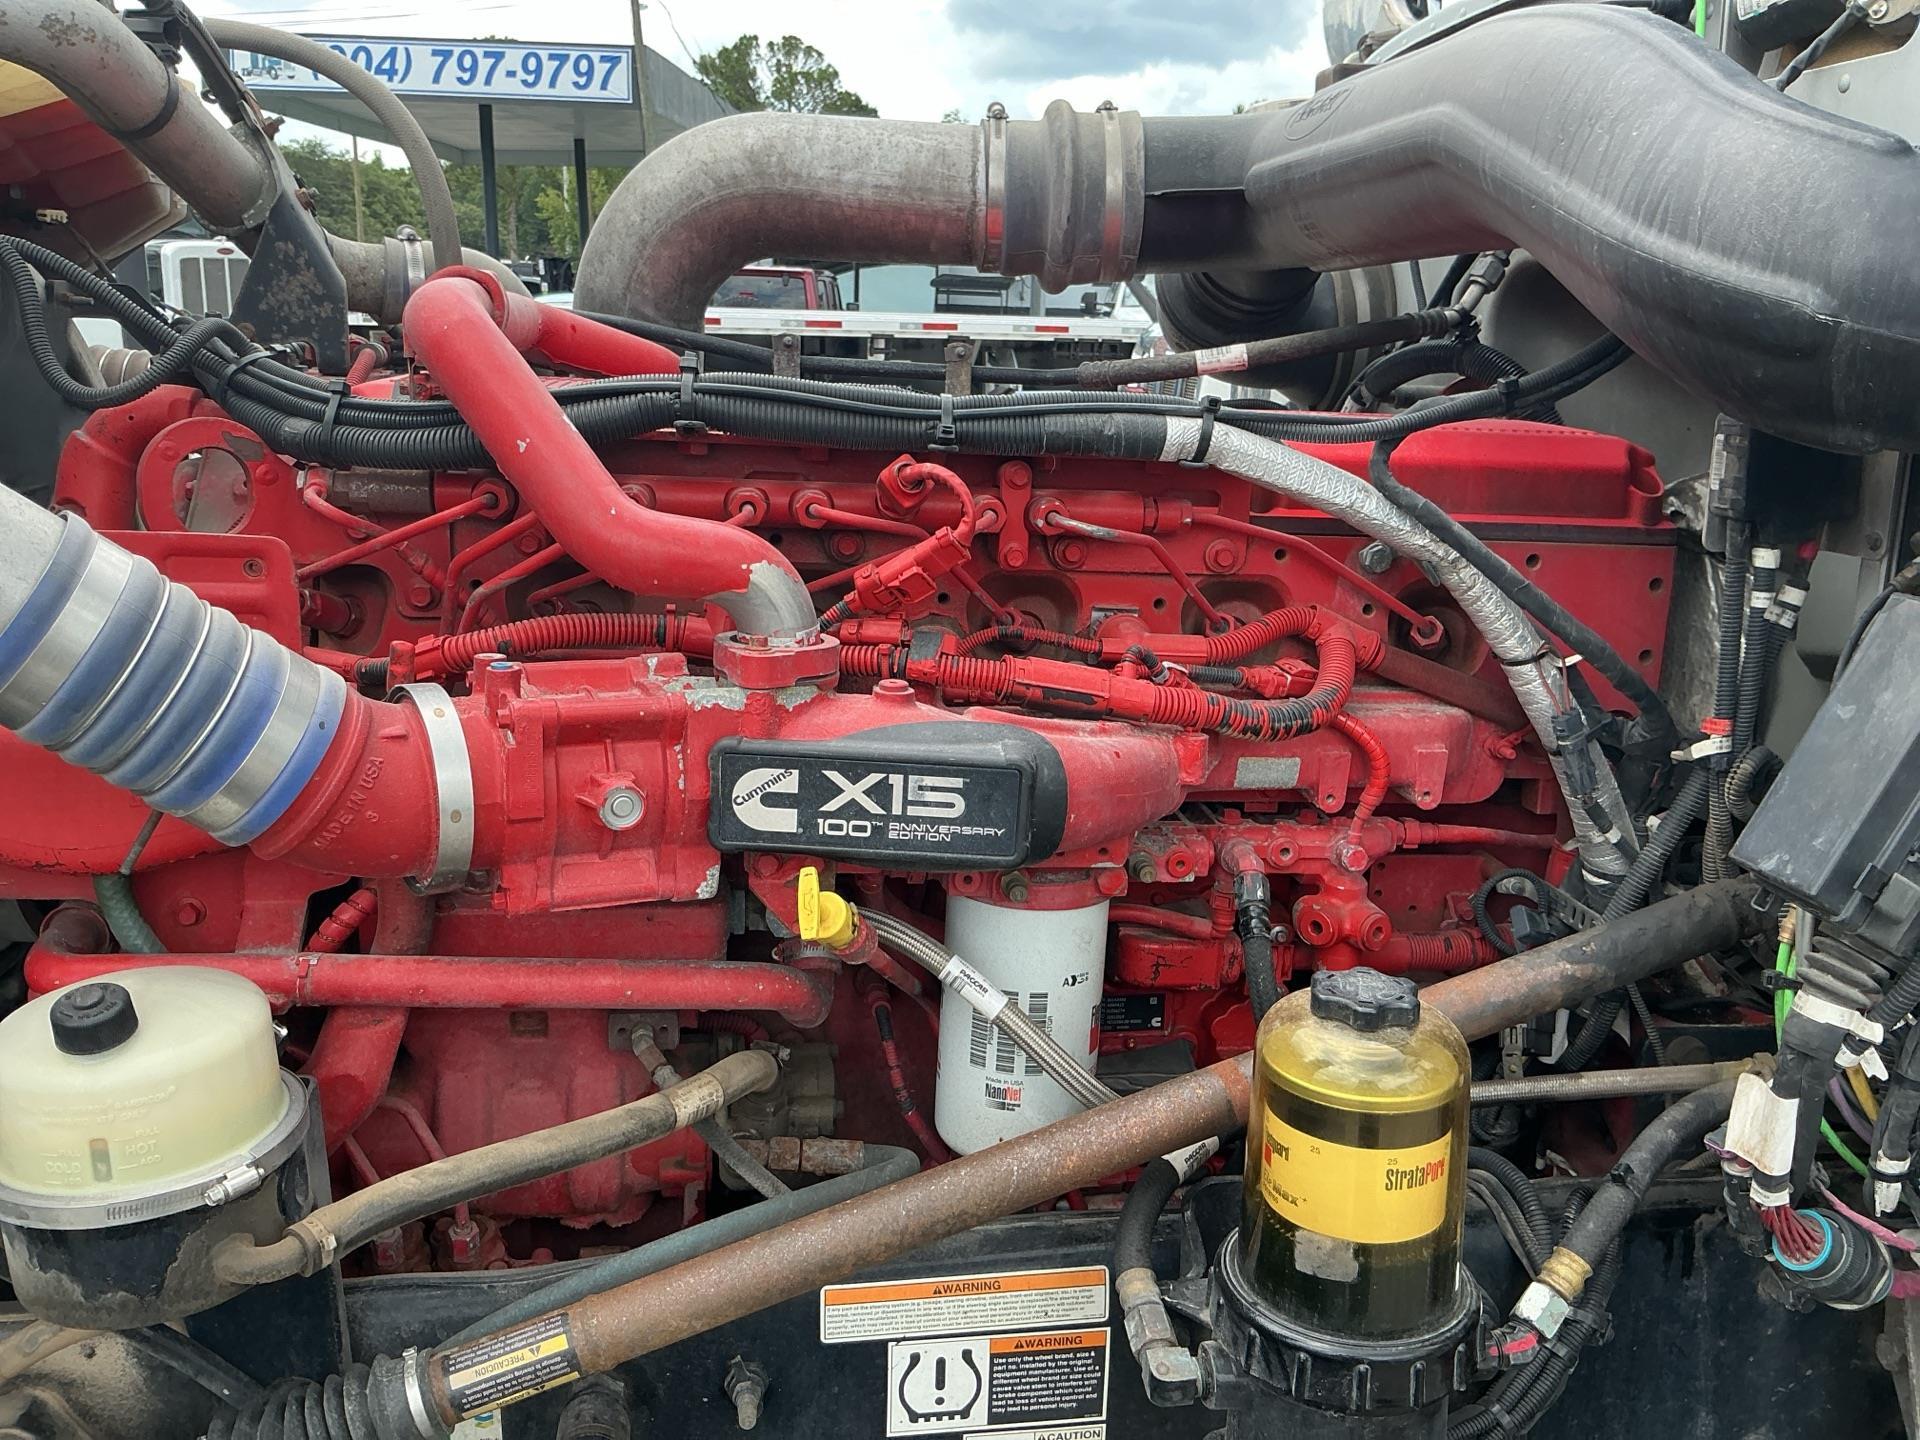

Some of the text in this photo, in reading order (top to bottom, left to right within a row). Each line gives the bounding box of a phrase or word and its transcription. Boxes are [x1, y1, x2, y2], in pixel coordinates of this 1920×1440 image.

[430, 48, 623, 92] 797-9797
[360, 756, 385, 789] USA
[732, 769, 793, 807] Cummins
[818, 770, 966, 819] X15
[888, 831, 951, 842] EDITION
[889, 822, 1006, 838] ANNIVERSARY
[959, 969, 989, 995] PACCAR
[125, 1139, 158, 1155] HOT
[1309, 1145, 1321, 1155] 25
[45, 1161, 81, 1174] COLD
[1386, 1158, 1398, 1166] 25
[942, 1280, 1001, 1294] WARNING
[1024, 1335, 1083, 1348] WARNING
[1047, 1430, 1101, 1440] CAUTION
